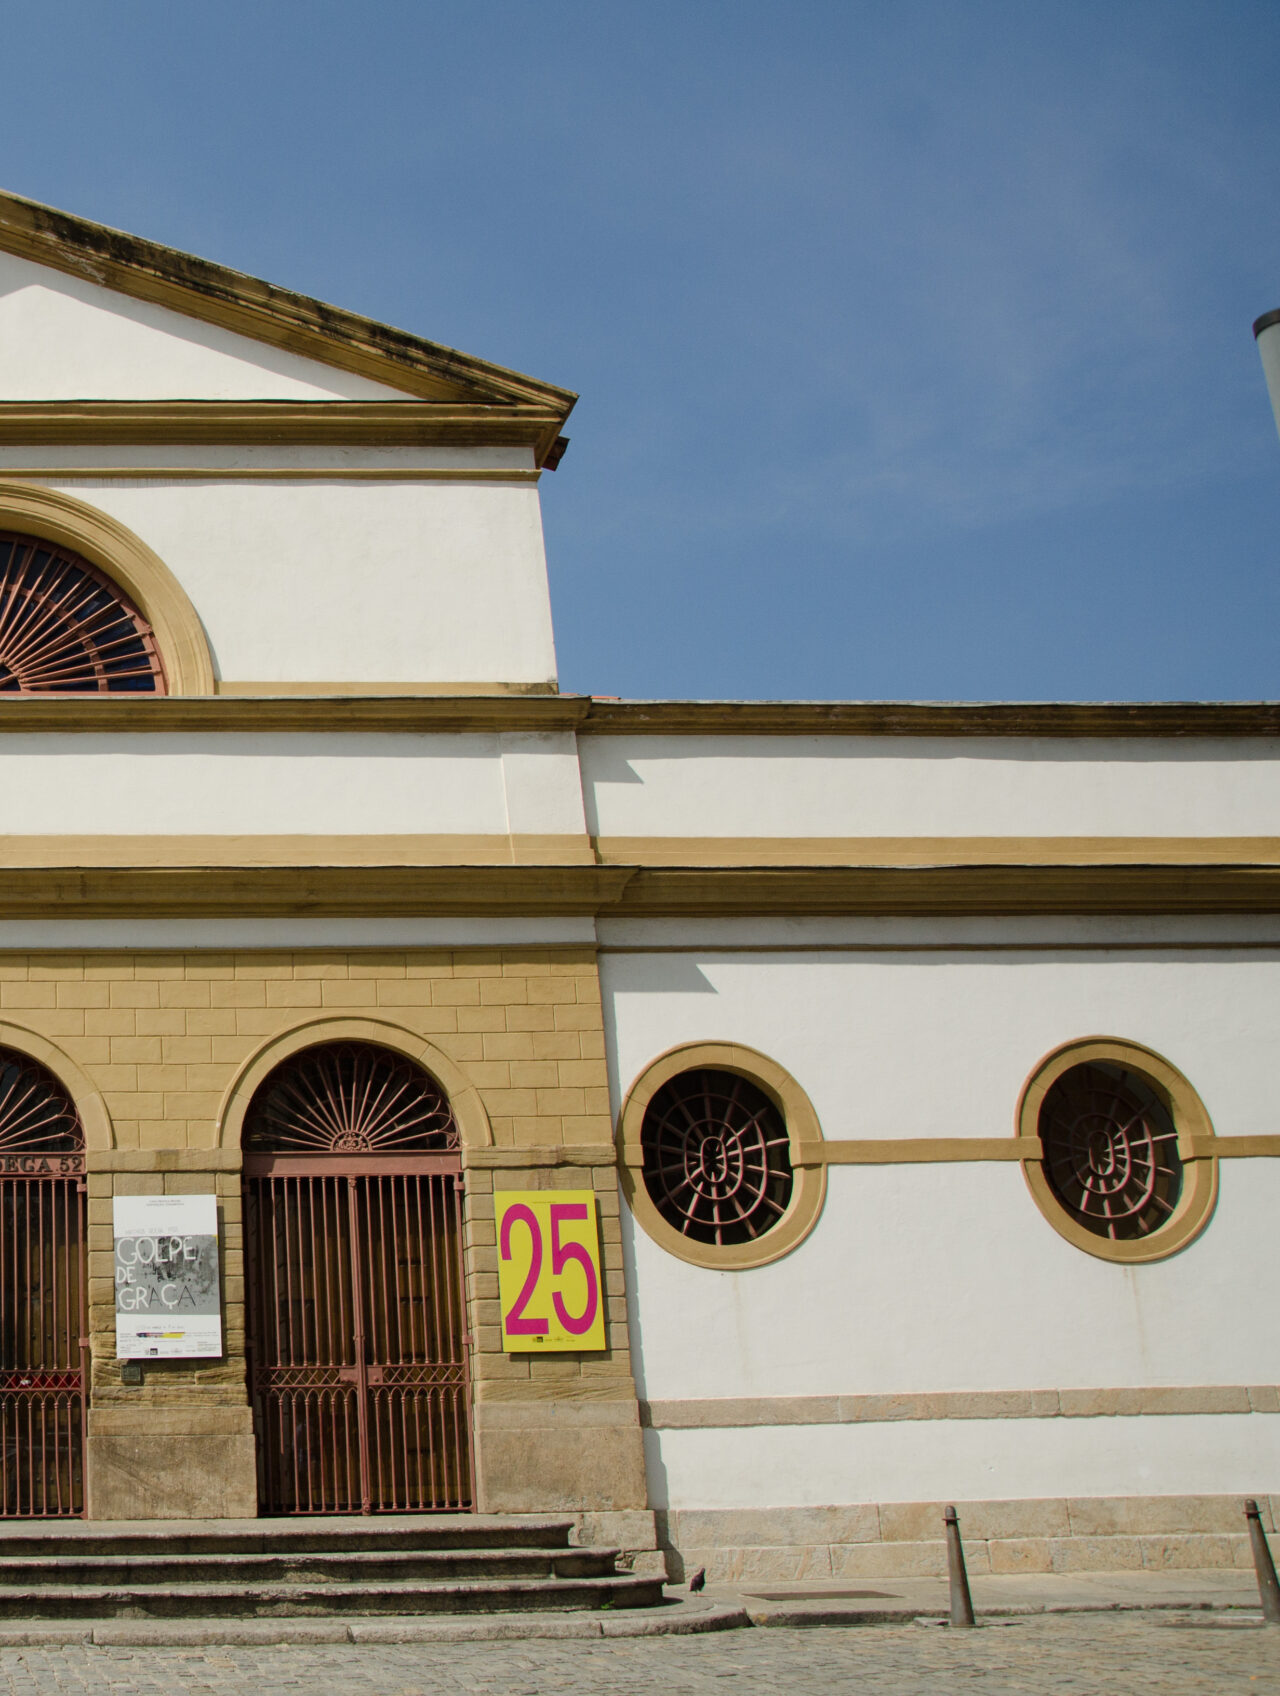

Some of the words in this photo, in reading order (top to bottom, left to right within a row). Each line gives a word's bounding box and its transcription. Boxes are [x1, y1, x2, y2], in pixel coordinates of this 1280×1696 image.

[60, 1155, 83, 1173] 52
[116, 1236, 196, 1266] GOLPE
[116, 1266, 137, 1284] DE
[500, 1203, 598, 1335] 25
[118, 1283, 197, 1311] GRAÇA
